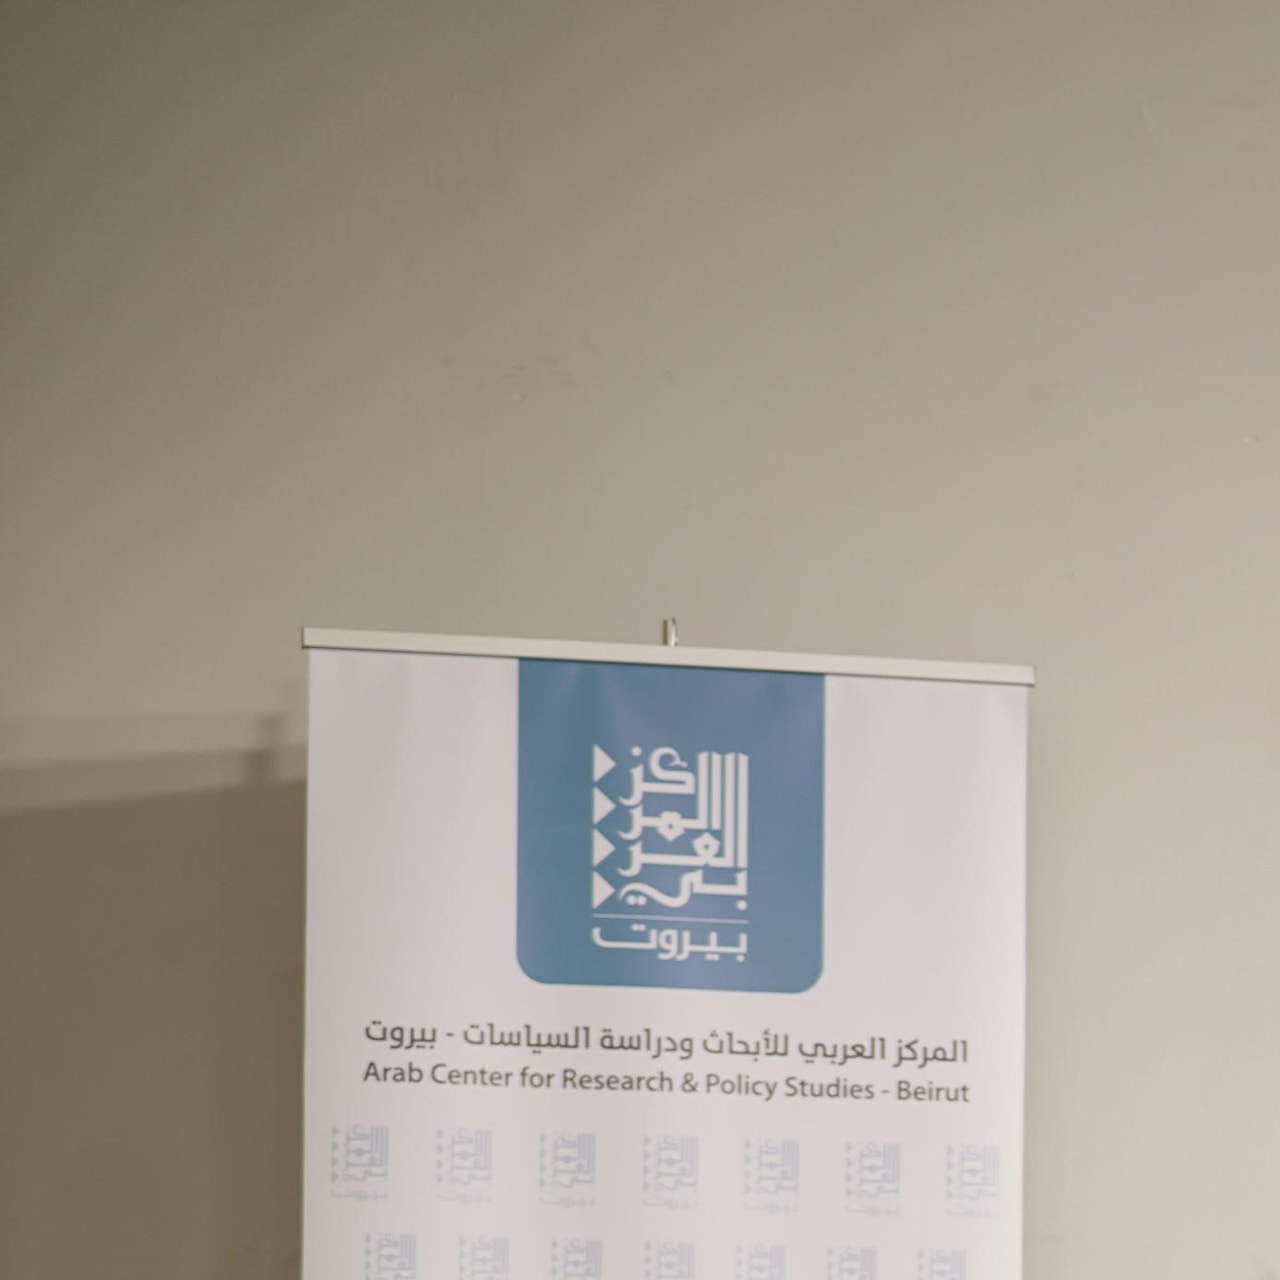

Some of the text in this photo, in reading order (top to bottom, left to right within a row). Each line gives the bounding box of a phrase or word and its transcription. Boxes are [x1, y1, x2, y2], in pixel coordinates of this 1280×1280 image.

[592, 923, 747, 961] بيروت
[364, 1020, 438, 1050] بيروت
[463, 1023, 591, 1054] السياسات
[599, 1027, 695, 1061] ودراسة
[702, 1029, 789, 1062] للأبحاث
[797, 1036, 887, 1067] العربي
[892, 1038, 969, 1069] المركز
[362, 1061, 424, 1084] Arab
[431, 1063, 514, 1088] Center
[520, 1065, 556, 1089] for
[562, 1067, 674, 1092] Research
[680, 1072, 699, 1093] &
[705, 1073, 779, 1102] Policy
[784, 1076, 875, 1099] Studies
[896, 1079, 971, 1103] Beirut
